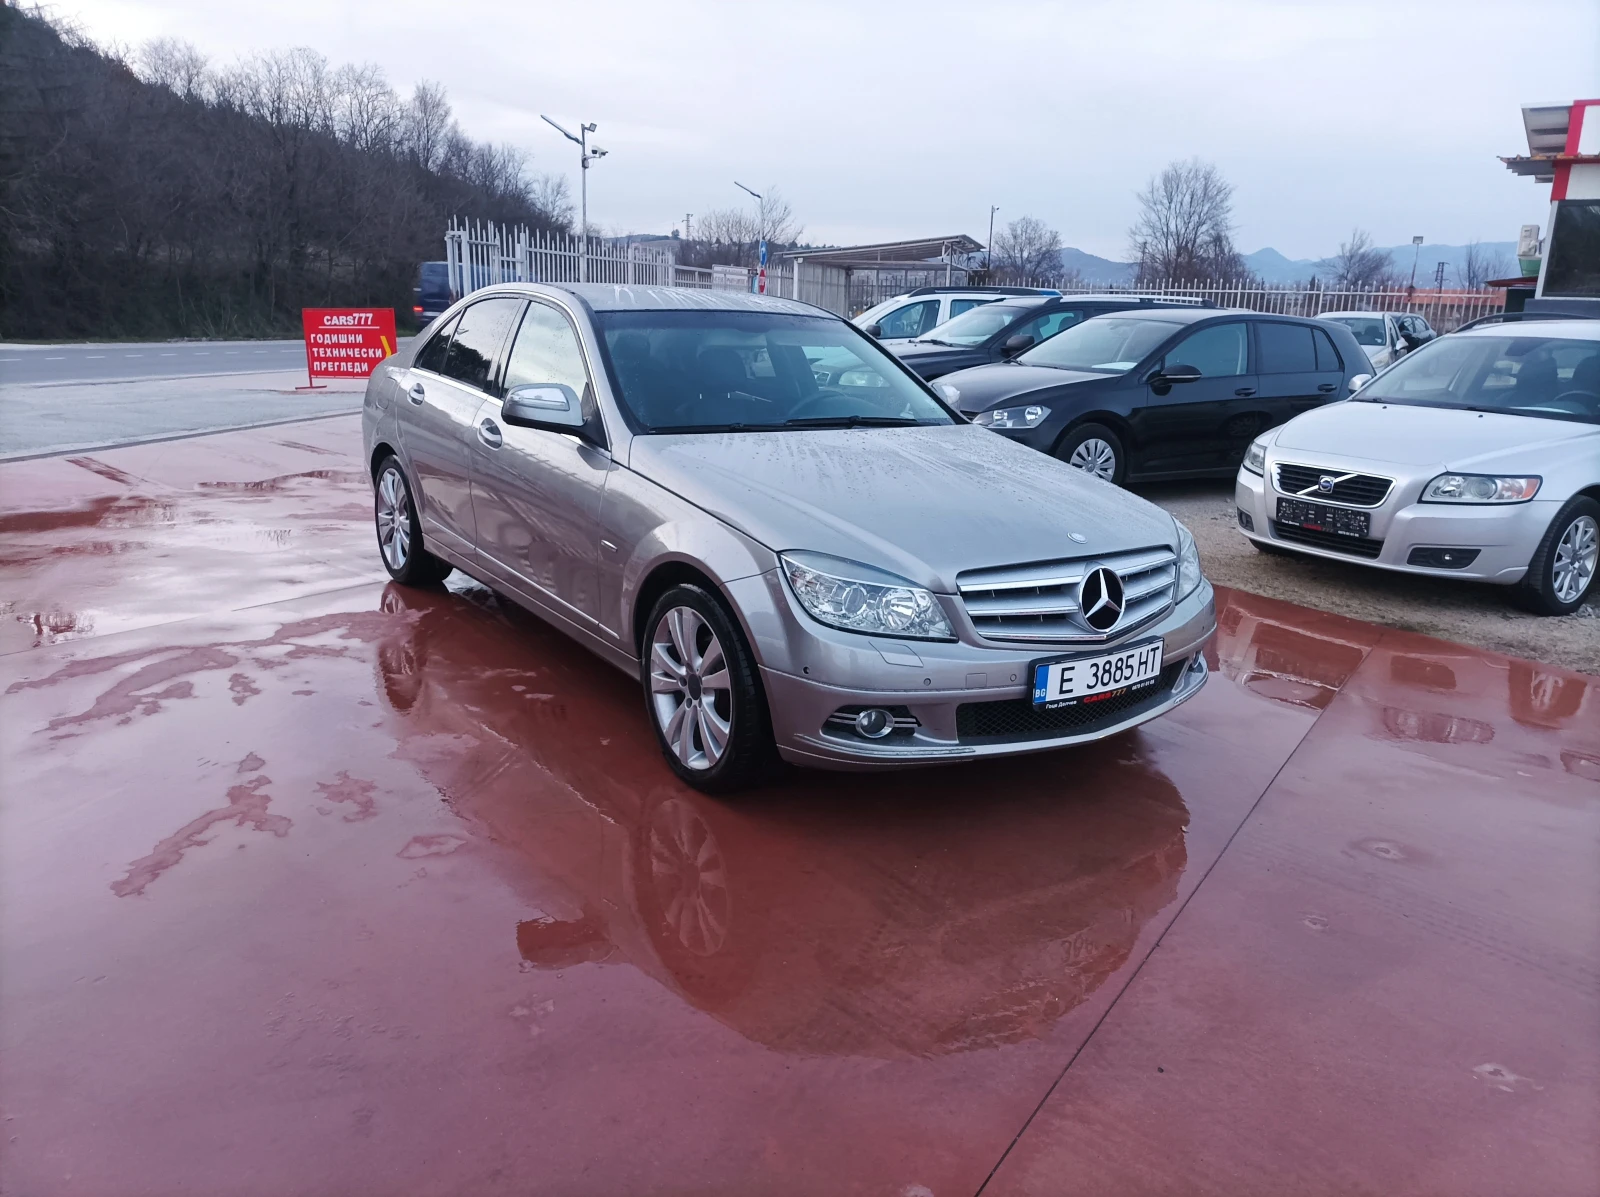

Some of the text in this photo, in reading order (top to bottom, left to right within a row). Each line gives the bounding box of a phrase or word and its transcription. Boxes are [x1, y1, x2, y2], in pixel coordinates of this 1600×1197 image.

[323, 313, 373, 325] CARS777
[310, 333, 363, 344] ГОДИШНИ
[312, 348, 382, 358] ТЕХНИЧЕСКИ
[313, 361, 368, 373] ПРЕГЛЕДИ
[1058, 666, 1076, 695] E
[1034, 688, 1046, 698] BG
[1083, 688, 1127, 703] CARS777
